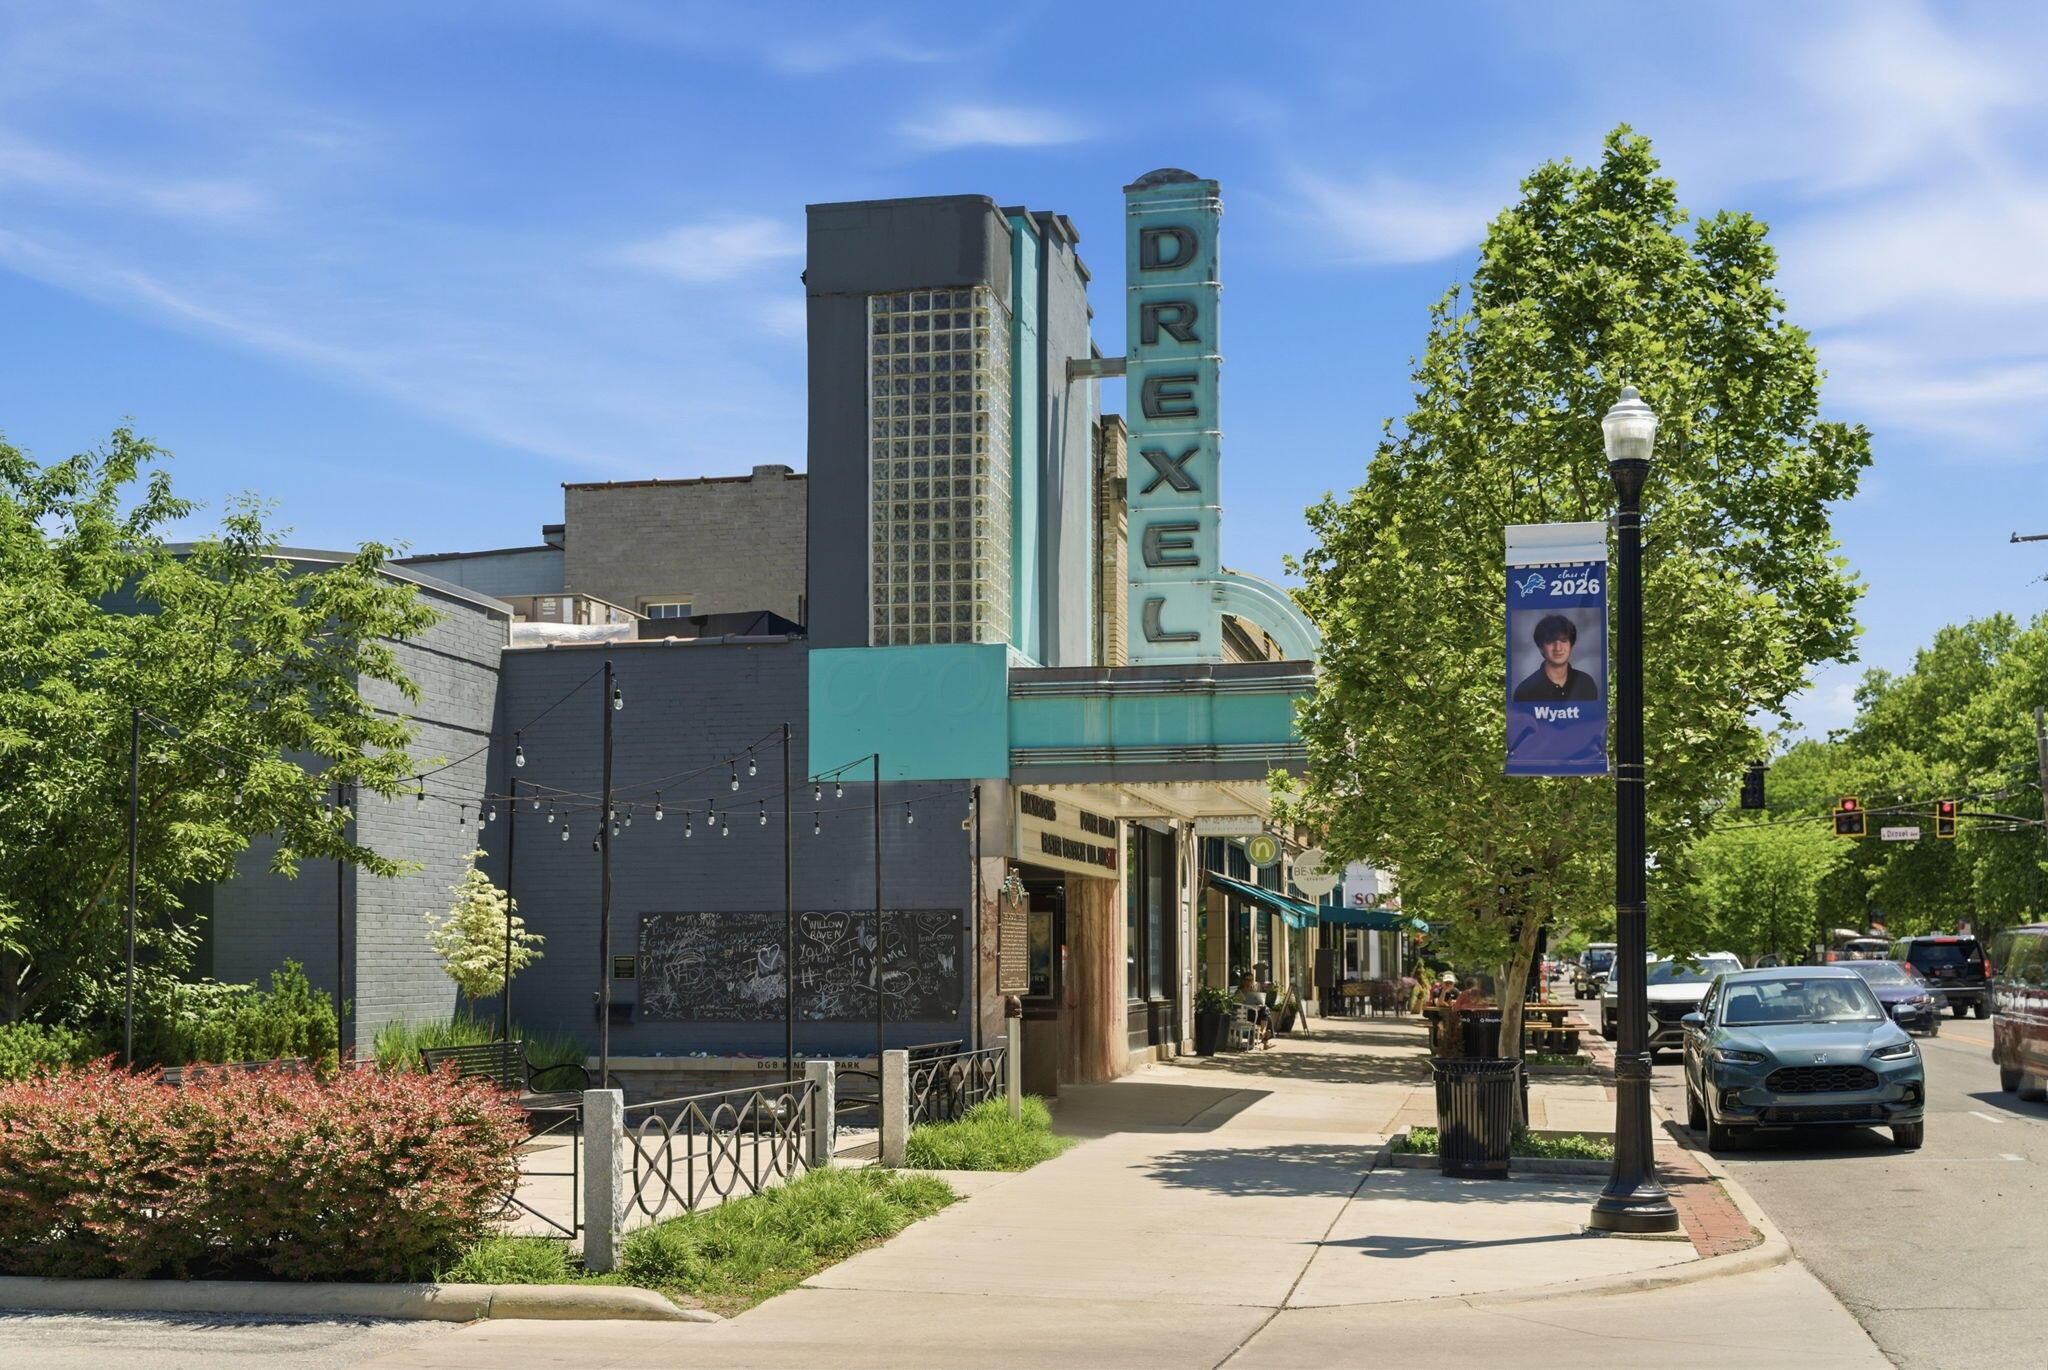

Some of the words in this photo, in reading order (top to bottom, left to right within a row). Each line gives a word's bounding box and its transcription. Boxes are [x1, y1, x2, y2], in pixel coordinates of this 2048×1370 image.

[1139, 225, 1202, 643] DREXEL
[1550, 578, 1600, 596] 2026
[1534, 706, 1580, 722] Wyatt
[808, 920, 844, 930] WILLOW
[809, 930, 841, 942] RAVEN
[835, 1061, 860, 1069] PARK
